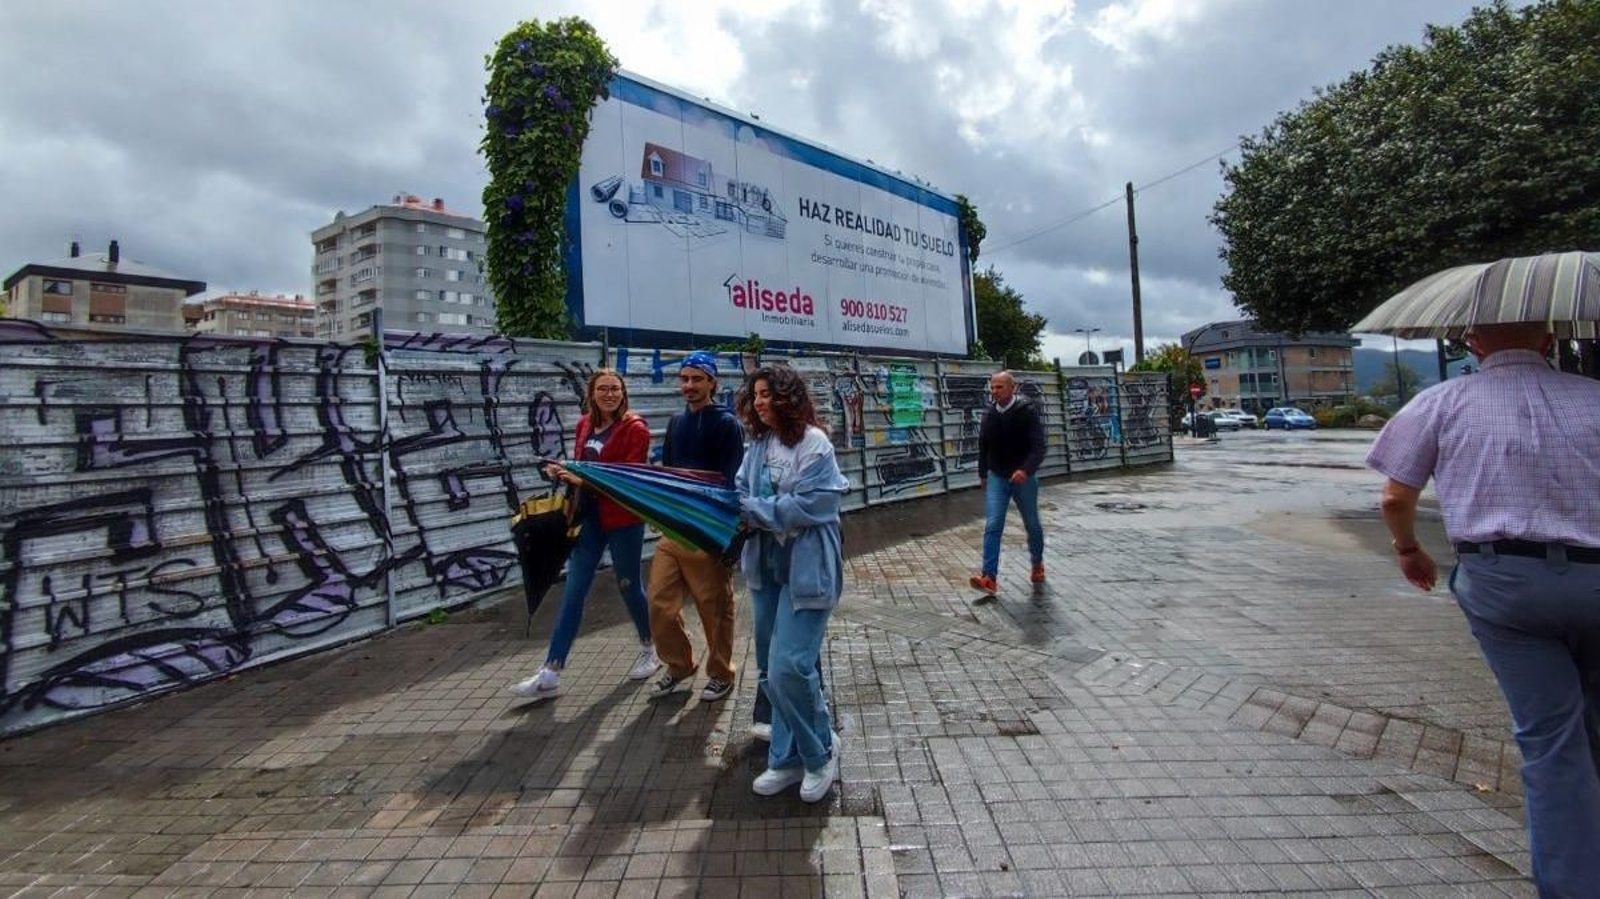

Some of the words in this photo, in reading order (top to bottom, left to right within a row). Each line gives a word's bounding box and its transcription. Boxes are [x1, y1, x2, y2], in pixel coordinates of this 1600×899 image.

[799, 197, 832, 224] HAZ
[834, 207, 901, 242] REALIDAD
[903, 227, 919, 247] TU
[921, 233, 954, 257] SUELO
[811, 250, 858, 271] desarrollar
[859, 262, 874, 274] una
[732, 279, 814, 316] aliseda
[840, 298, 865, 318] 900
[866, 301, 887, 321] 810
[888, 305, 908, 324] 527
